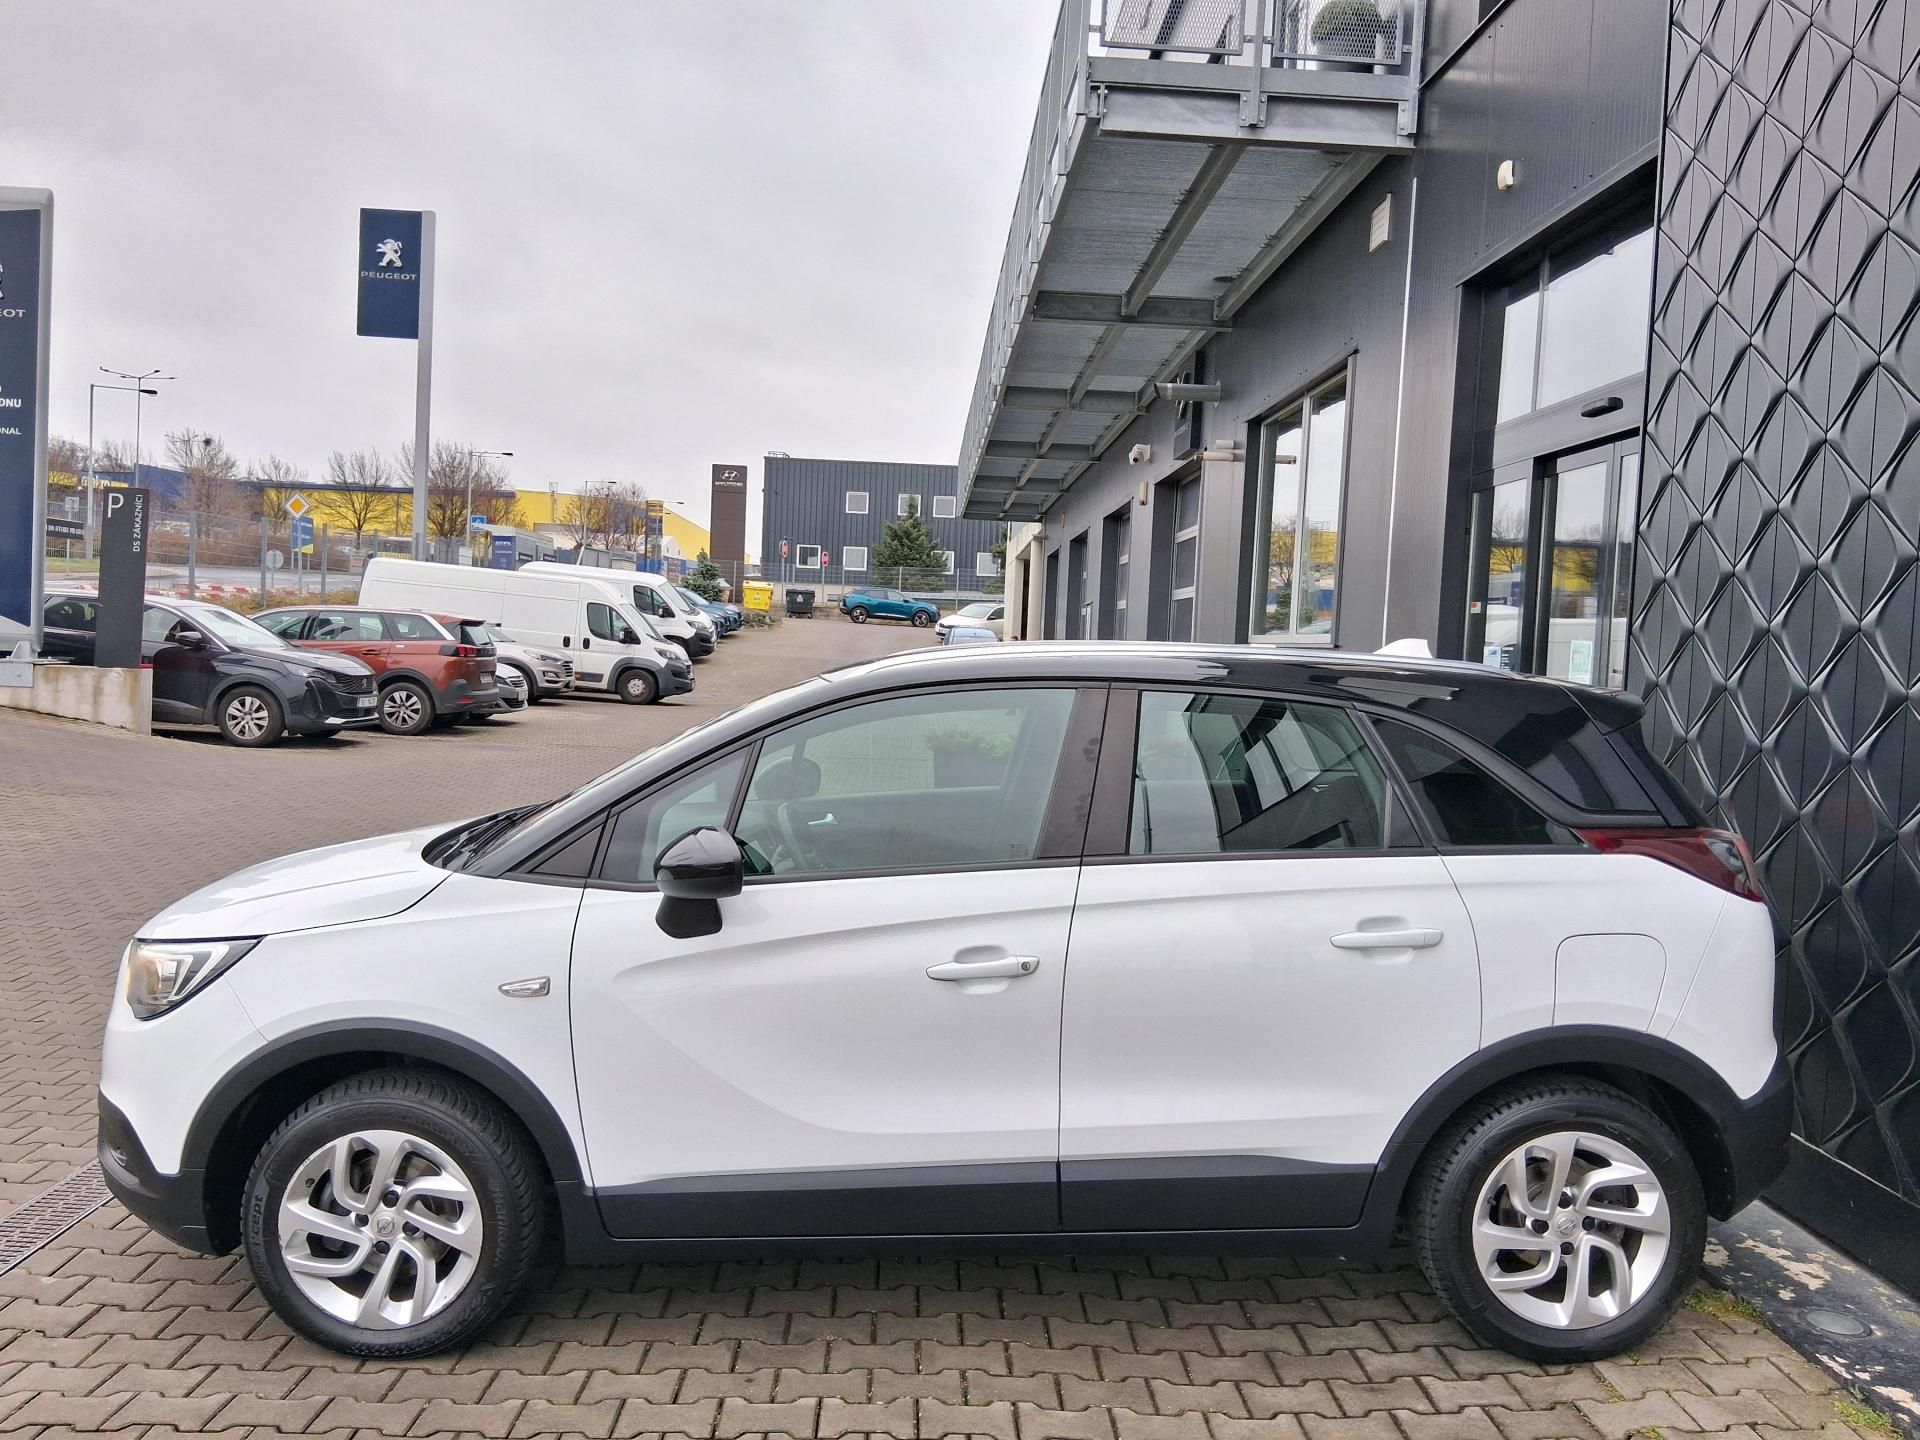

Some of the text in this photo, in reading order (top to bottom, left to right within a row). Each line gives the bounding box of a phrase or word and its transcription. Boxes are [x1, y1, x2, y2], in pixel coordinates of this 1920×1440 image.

[361, 271, 417, 280] PEUGEOT
[107, 493, 124, 518] P
[132, 541, 141, 552] DS
